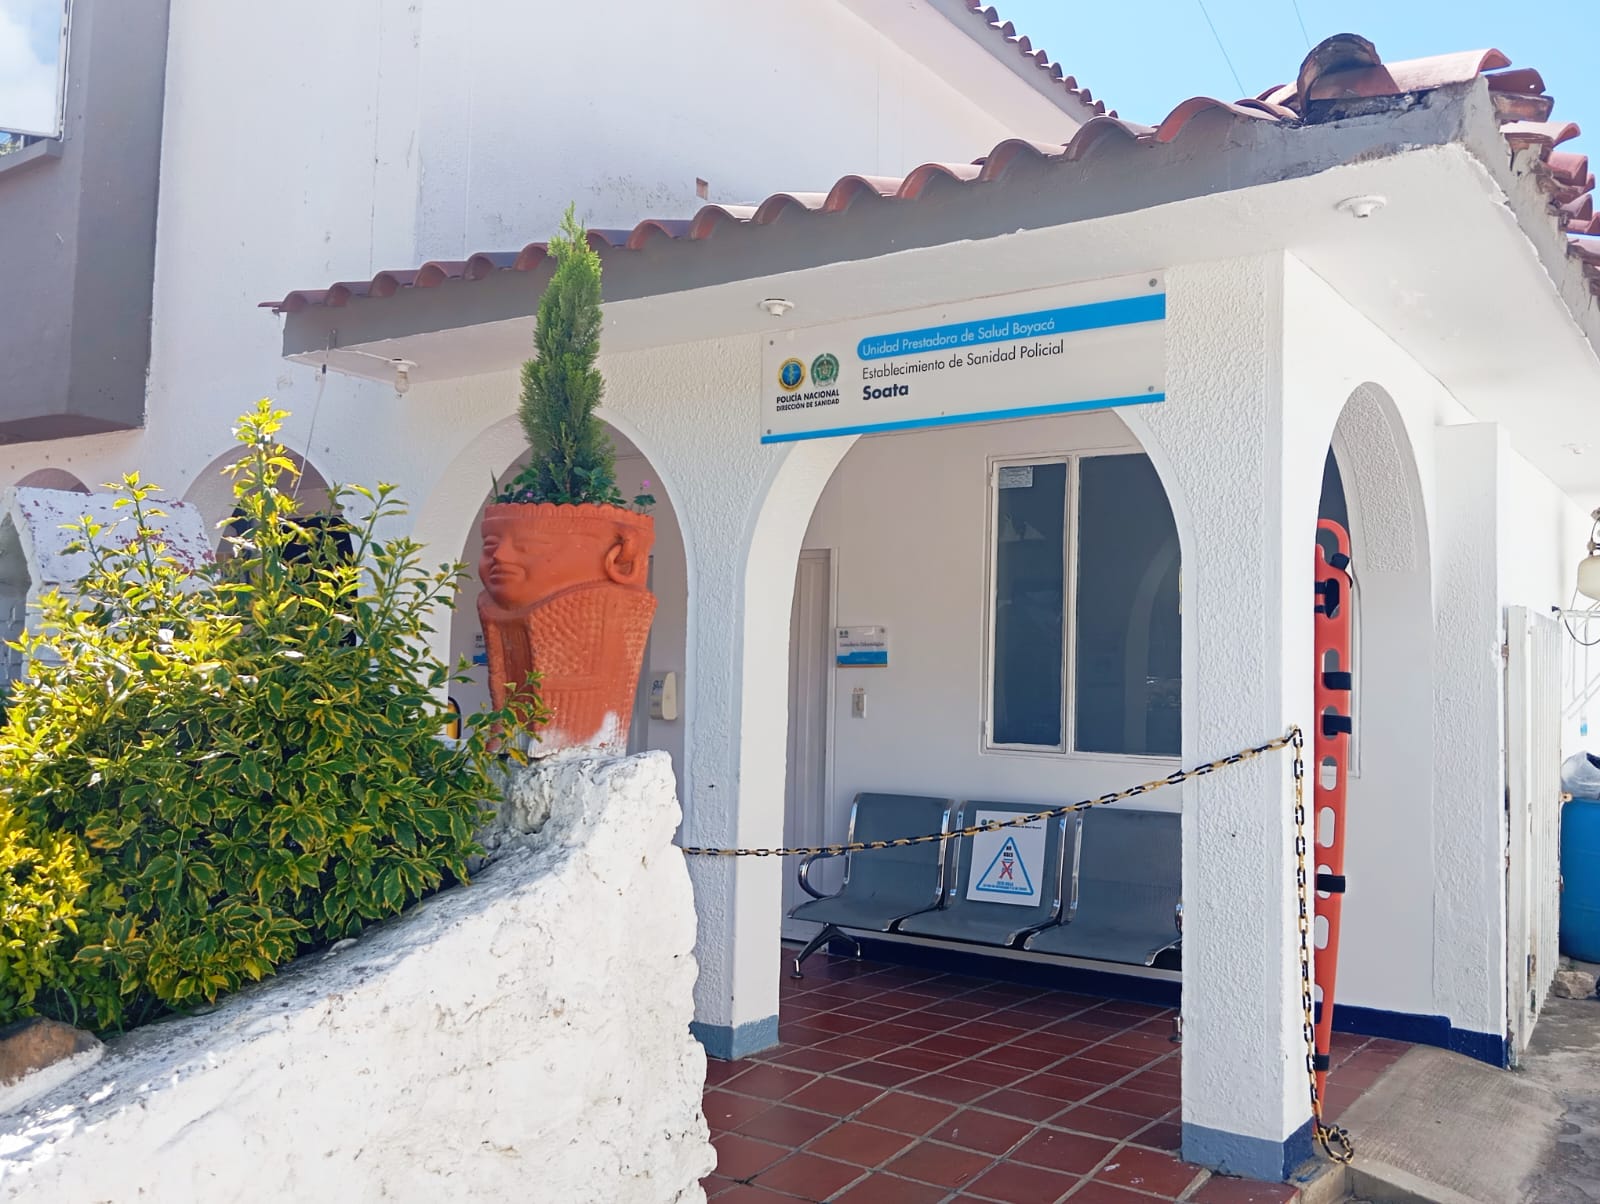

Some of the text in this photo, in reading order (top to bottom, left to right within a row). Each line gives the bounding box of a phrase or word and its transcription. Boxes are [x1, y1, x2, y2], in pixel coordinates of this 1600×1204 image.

[862, 317, 1055, 356] Unidad Prestadora de Salud Boyacá
[862, 338, 1064, 380] Establecimiento de Sanidad Policial
[776, 388, 840, 404] POLICÍA NACIONAL
[862, 383, 909, 401] Soata
[806, 401, 813, 409] DE
[814, 398, 840, 407] SANIDAD
